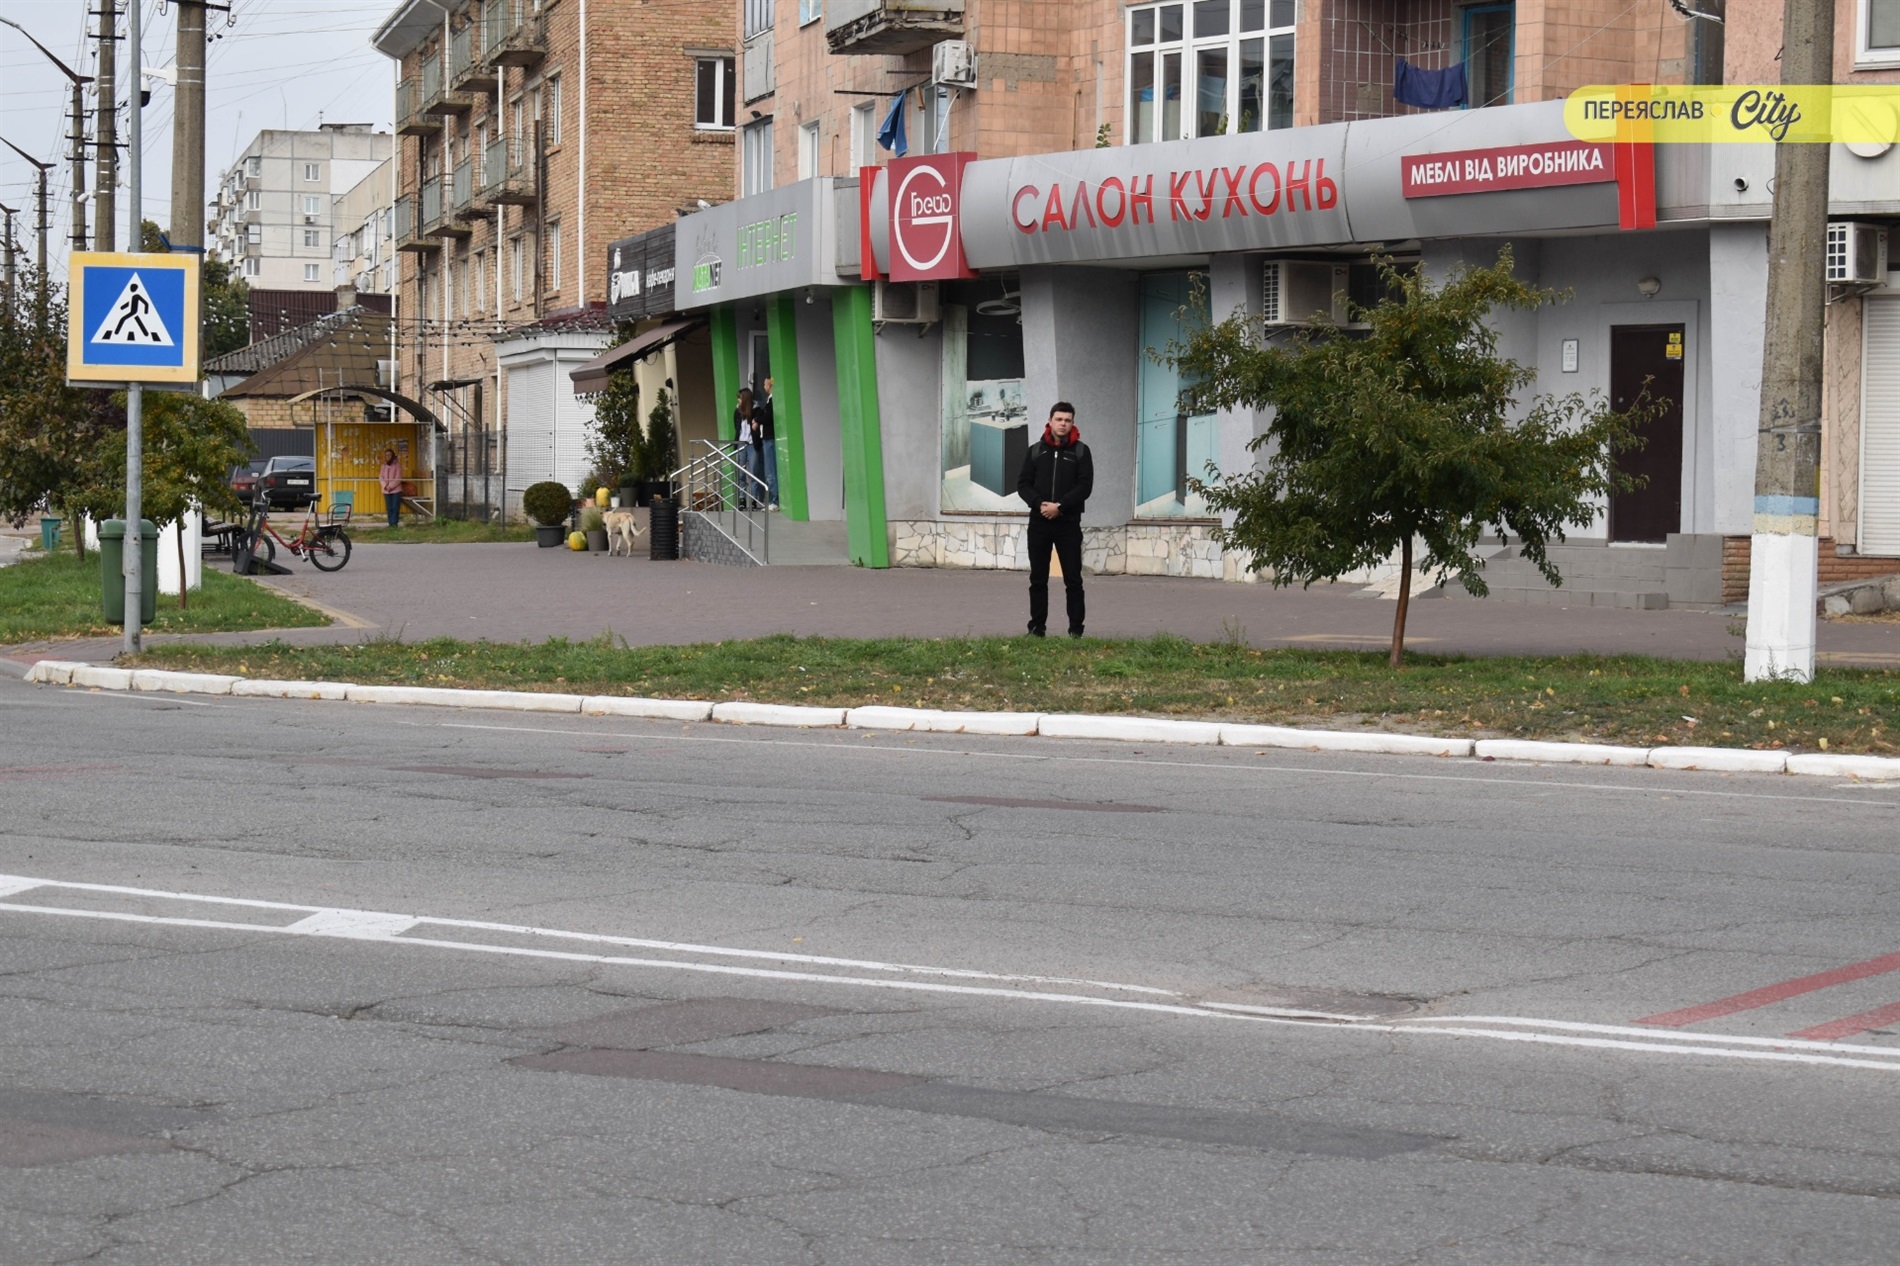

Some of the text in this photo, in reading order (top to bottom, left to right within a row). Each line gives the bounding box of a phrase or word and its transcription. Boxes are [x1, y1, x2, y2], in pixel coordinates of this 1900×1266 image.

[1011, 157, 1338, 235] САЛОН КУХОНЬ
[1410, 148, 1604, 186] МЕБЛІ ВІД ВИРОБНИКА
